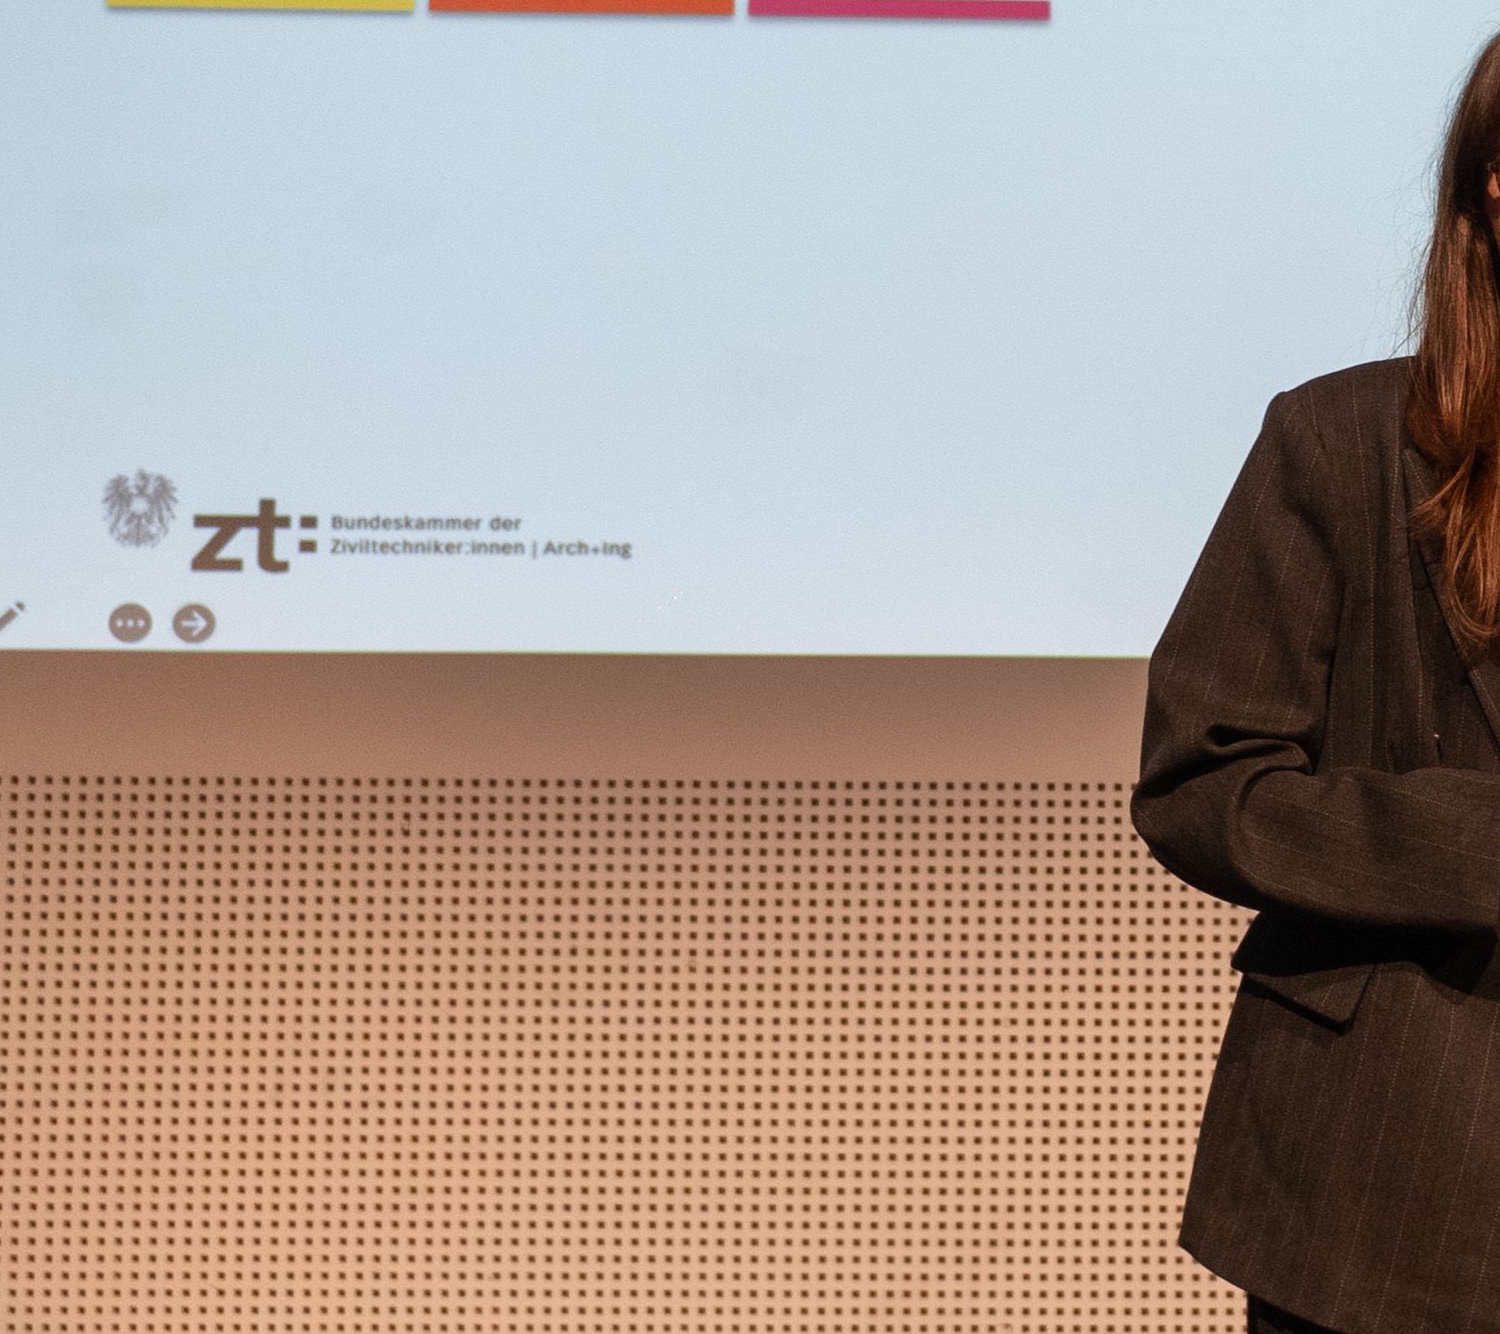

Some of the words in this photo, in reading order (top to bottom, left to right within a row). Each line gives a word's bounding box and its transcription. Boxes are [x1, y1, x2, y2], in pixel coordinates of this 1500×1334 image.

[330, 514, 482, 532] Bundeskammer
[489, 514, 522, 531] der
[329, 538, 525, 556] Ziviltechniker:innen
